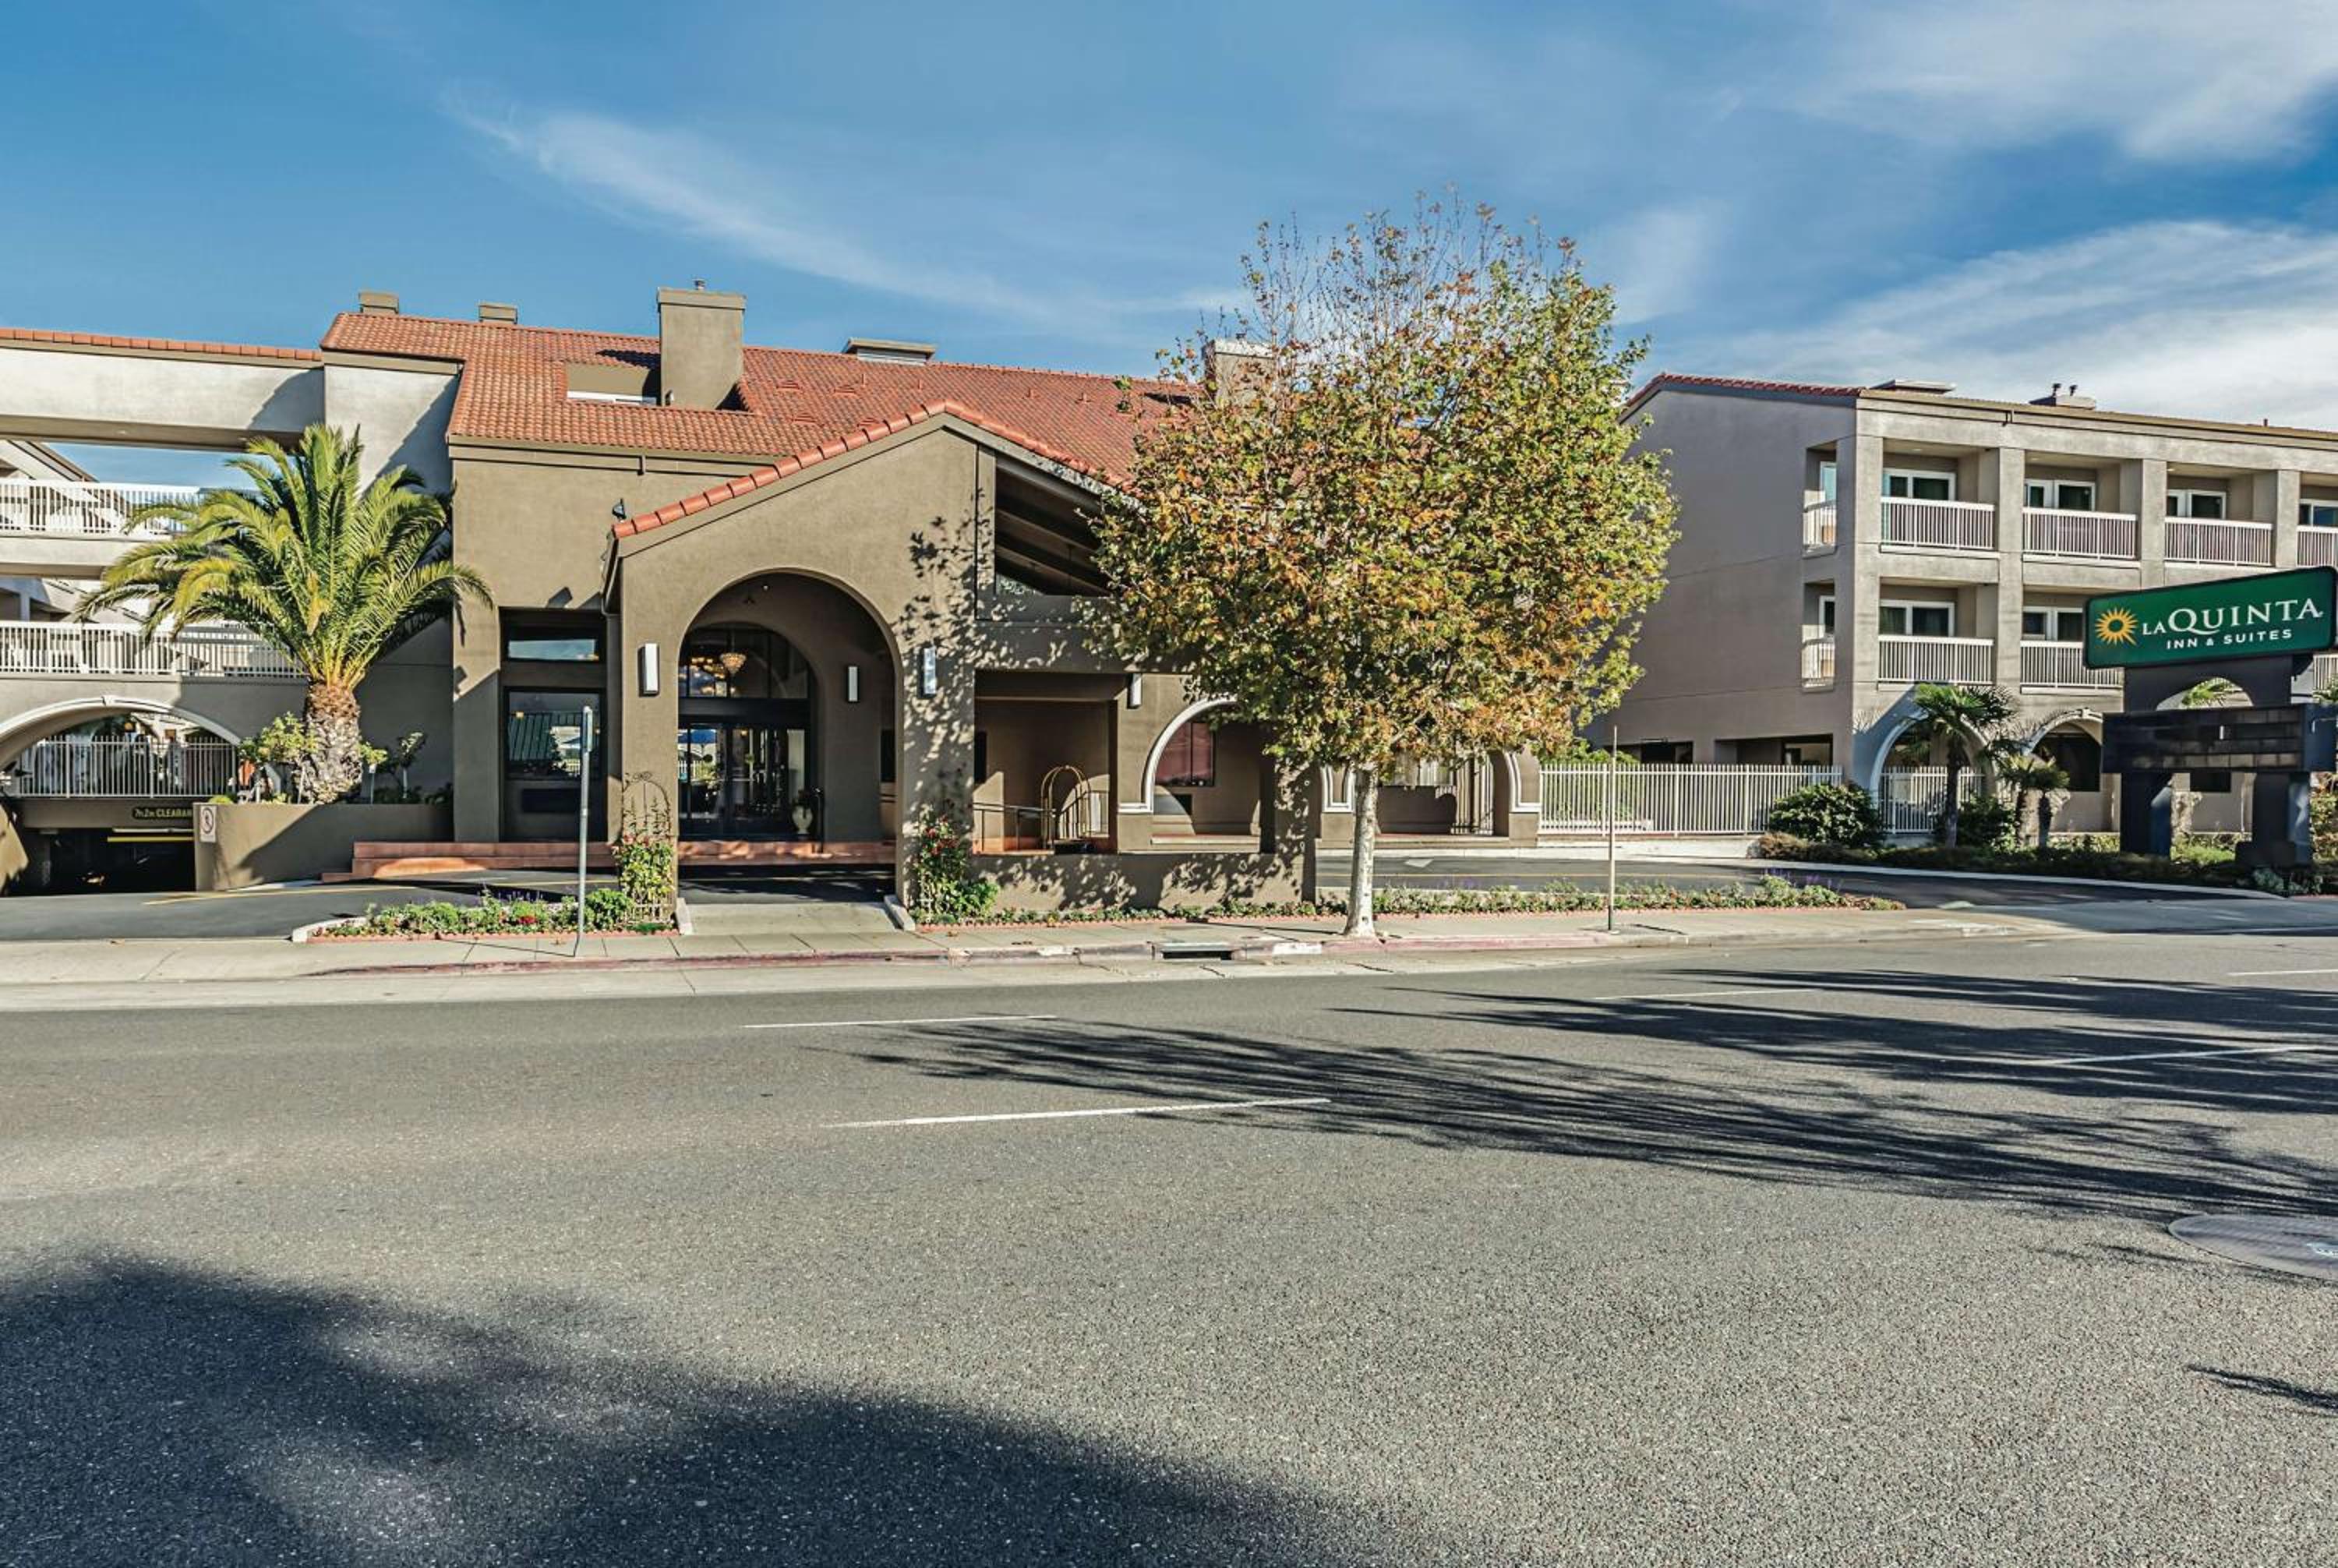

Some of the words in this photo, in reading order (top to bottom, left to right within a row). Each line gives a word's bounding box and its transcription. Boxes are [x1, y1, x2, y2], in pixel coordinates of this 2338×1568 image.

[2142, 620, 2167, 635] LA
[2168, 598, 2322, 635] QUINTA
[2166, 638, 2198, 649] INN
[2223, 629, 2293, 645] SUITES
